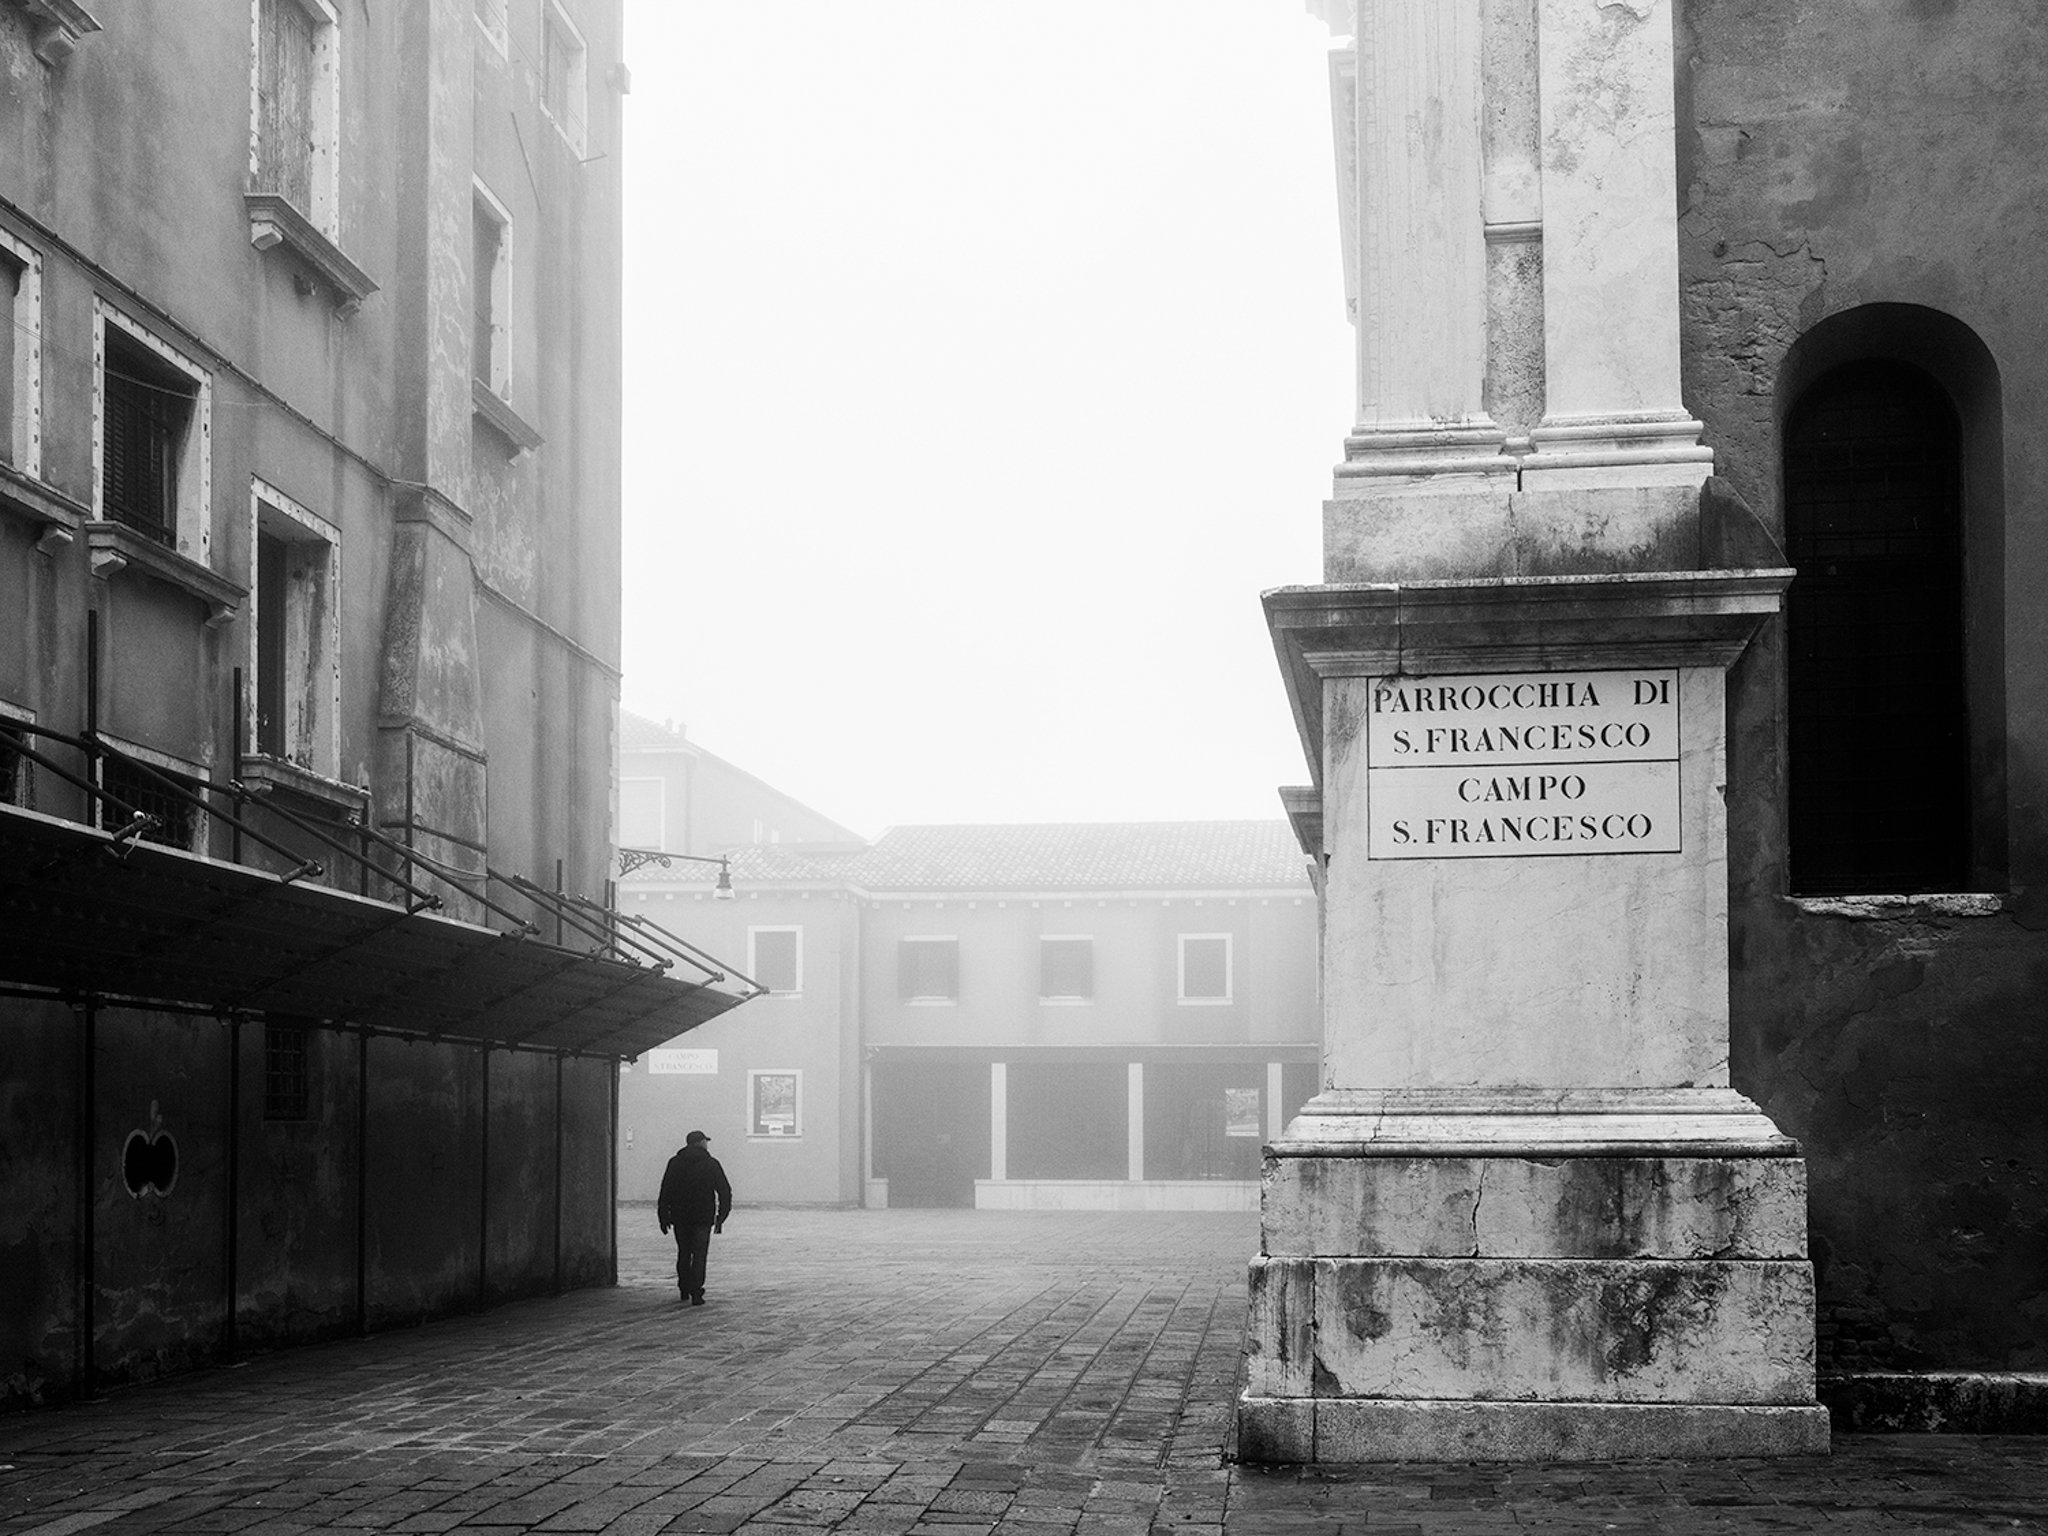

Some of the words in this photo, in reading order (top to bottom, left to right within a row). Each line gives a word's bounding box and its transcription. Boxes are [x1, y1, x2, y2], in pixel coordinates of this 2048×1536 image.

[1374, 682, 1601, 713] PARROCCHIA
[1633, 680, 1671, 706] DI
[1393, 722, 1651, 755] S.FRANCESCO
[1458, 775, 1586, 803] CAMPO
[1393, 813, 1653, 845] S.FRANCESCO
